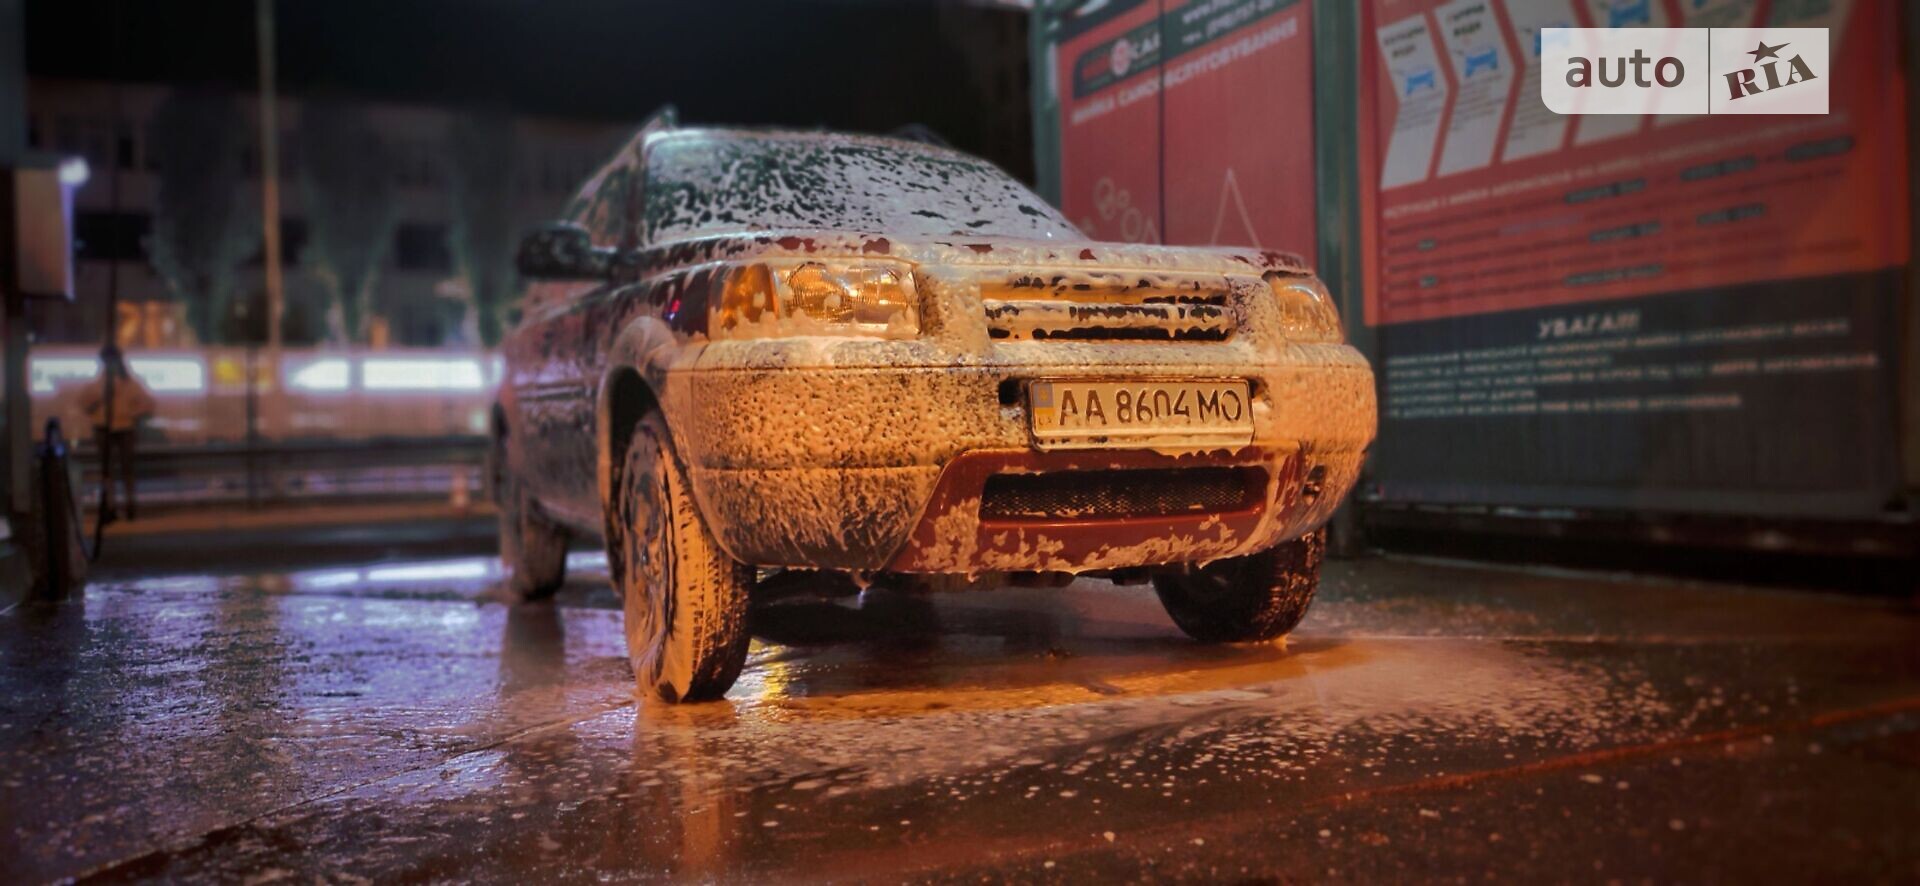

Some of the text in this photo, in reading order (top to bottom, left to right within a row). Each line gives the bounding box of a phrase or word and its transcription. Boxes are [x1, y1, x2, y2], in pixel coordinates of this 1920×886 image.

[1059, 388, 1243, 426] AA 8604 MO
